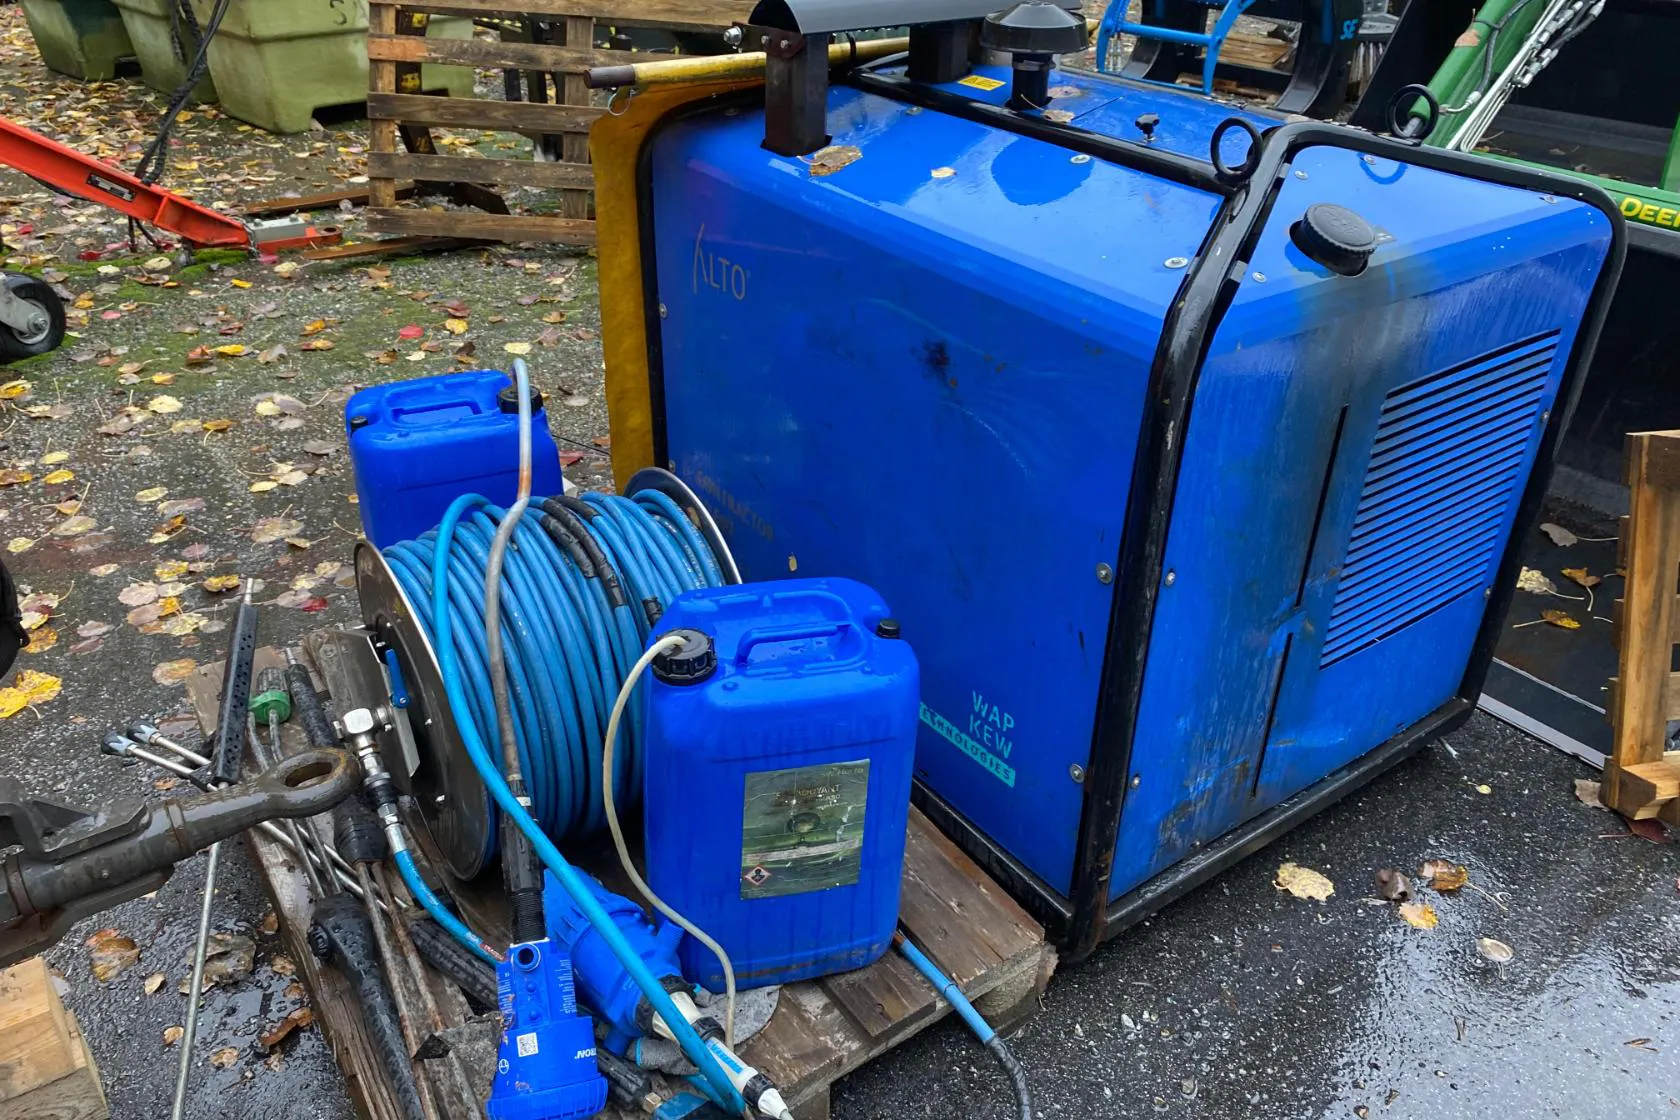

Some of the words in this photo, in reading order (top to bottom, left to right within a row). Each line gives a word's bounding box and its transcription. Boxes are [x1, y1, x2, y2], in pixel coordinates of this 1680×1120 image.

[693, 223, 746, 301] ALTO
[972, 690, 1015, 733] WAP
[969, 713, 1013, 760] KEW
